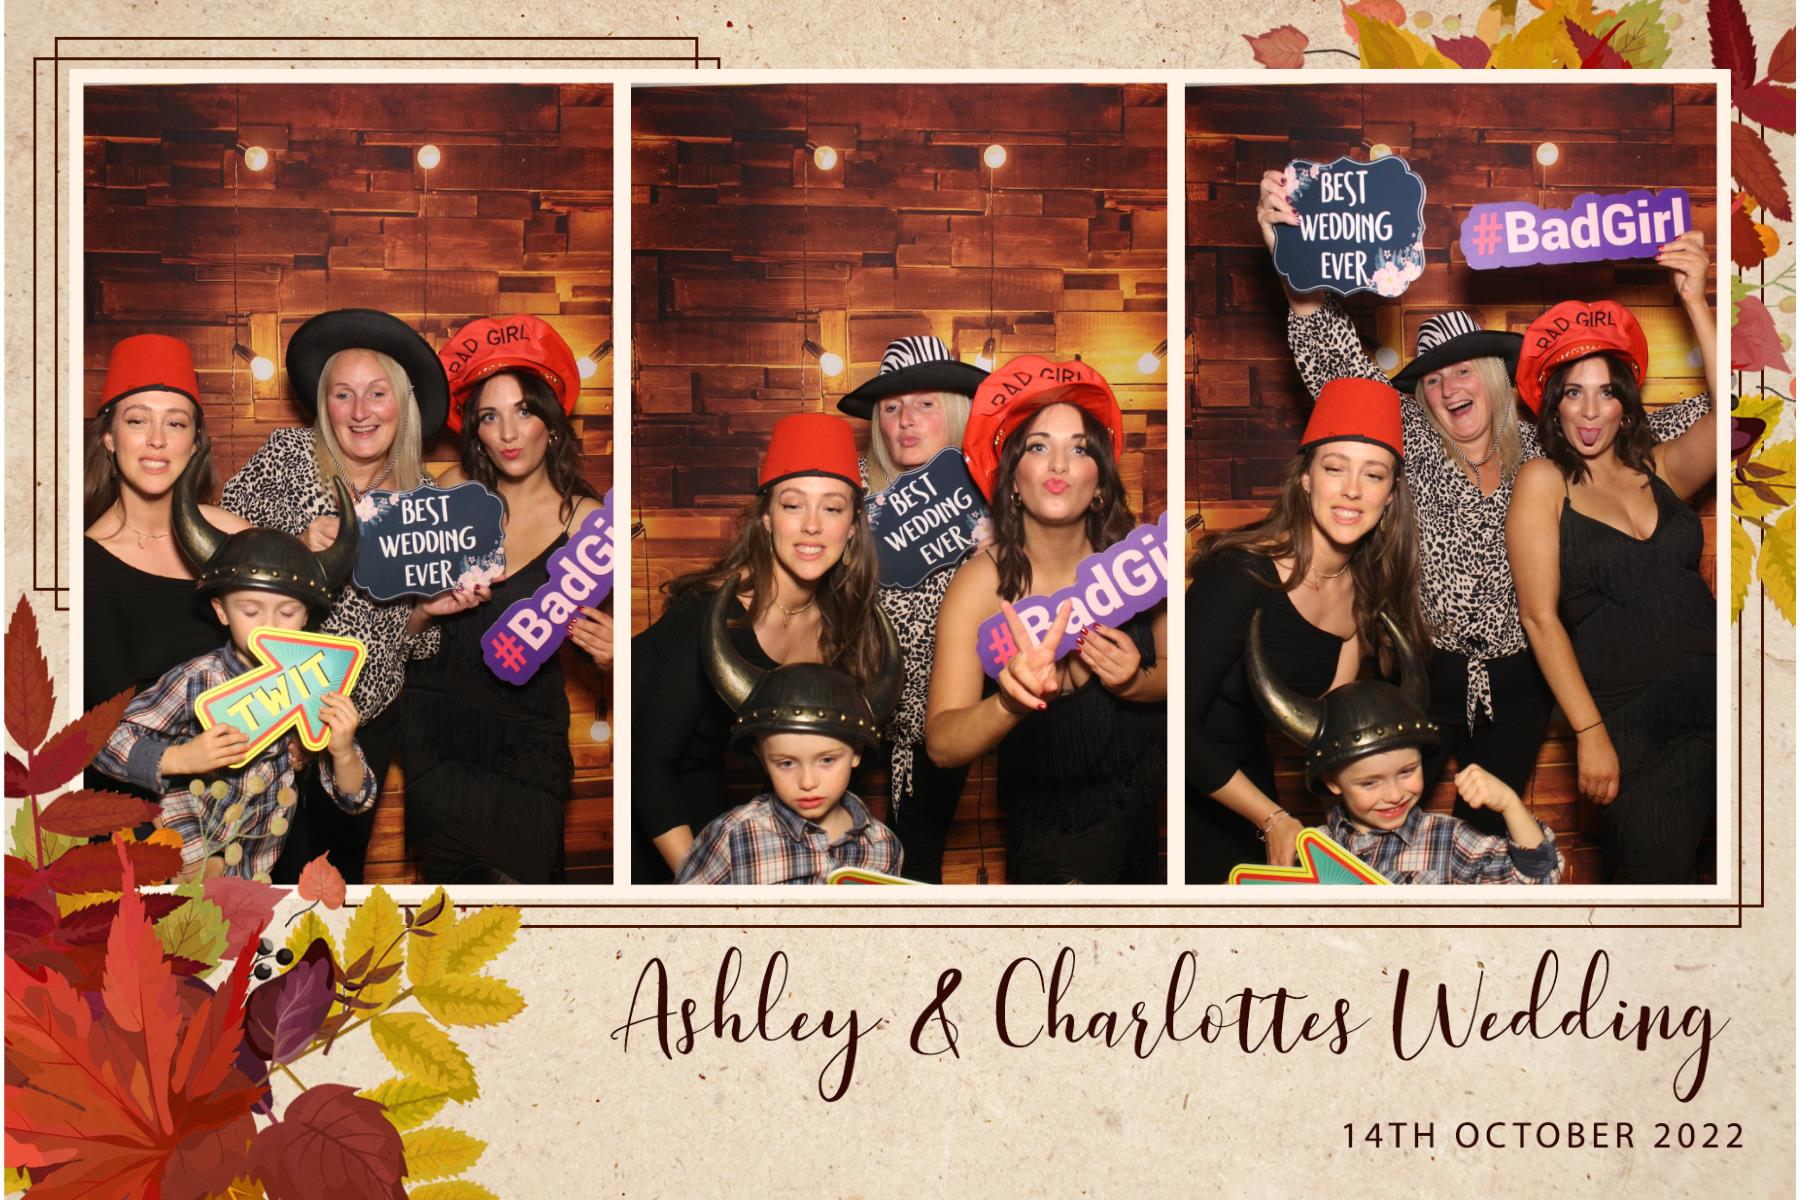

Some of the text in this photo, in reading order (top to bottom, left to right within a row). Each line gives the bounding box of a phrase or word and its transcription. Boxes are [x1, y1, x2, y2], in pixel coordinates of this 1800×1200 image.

[1321, 170, 1368, 207] BEST
[1298, 211, 1393, 243] WEDDING
[1471, 197, 1685, 257] #BadGirl
[1321, 250, 1370, 287] EVER
[486, 324, 530, 346] GIRL
[1575, 311, 1617, 328] GIRL
[401, 495, 450, 526] BEST
[888, 472, 938, 517] BEST
[883, 486, 973, 552] WEDDING
[378, 525, 477, 558] WEDDING
[920, 525, 974, 565] EVER
[404, 559, 457, 589] EVER
[226, 650, 331, 732] TWIT
